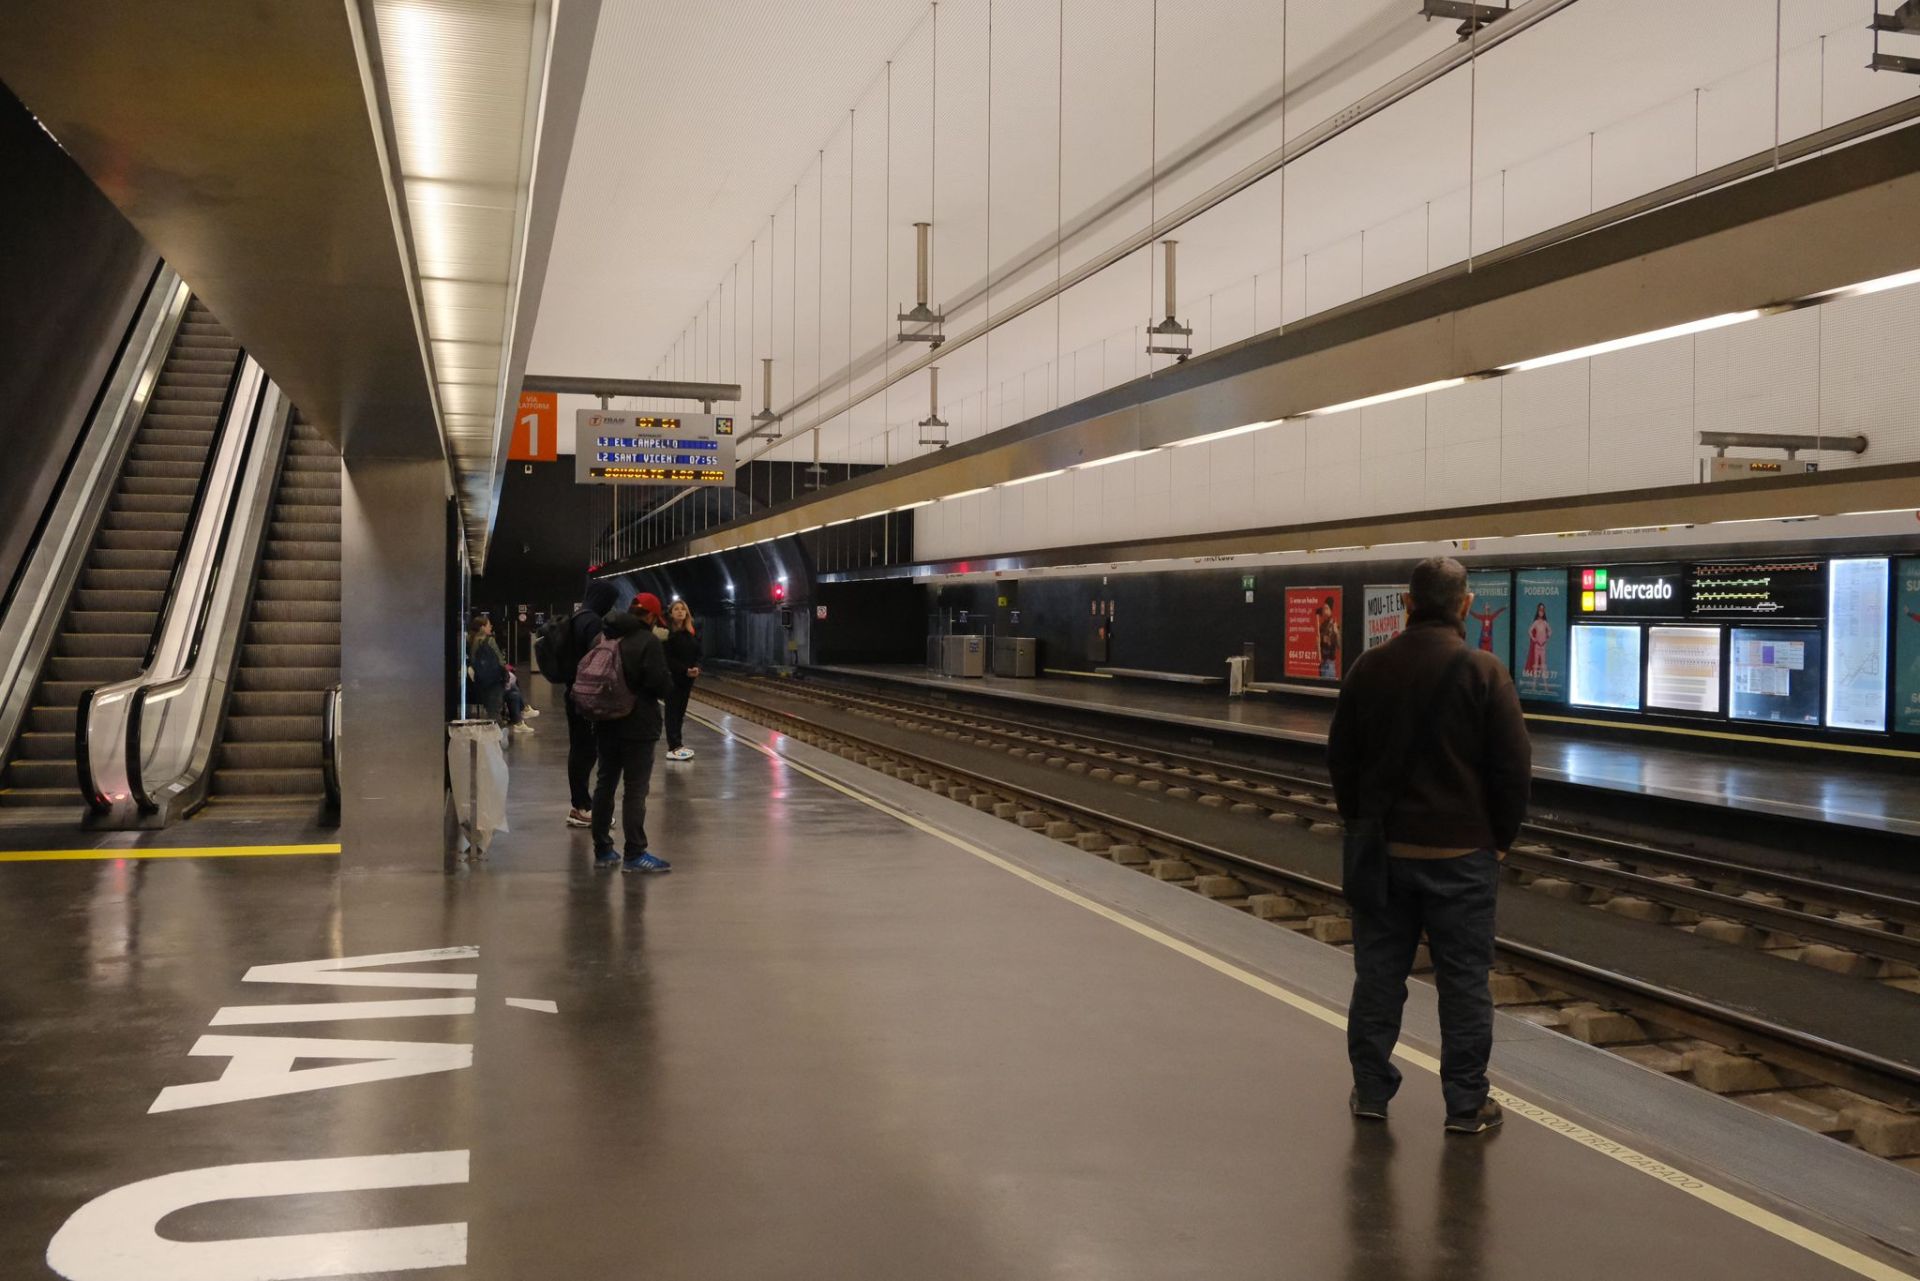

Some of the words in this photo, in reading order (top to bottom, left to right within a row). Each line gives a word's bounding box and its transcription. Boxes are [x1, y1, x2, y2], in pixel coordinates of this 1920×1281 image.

[521, 413, 539, 457] 1
[596, 437, 609, 447] L3
[614, 438, 626, 448] EL
[596, 452, 609, 462] L2
[614, 453, 637, 463] SANT
[1524, 587, 1560, 596] PODEROSA
[1609, 579, 1672, 599] Mercado
[1540, 1117, 1583, 1134] CON
[1576, 1134, 1627, 1154] TREN
[1620, 1155, 1704, 1189] PARADO
